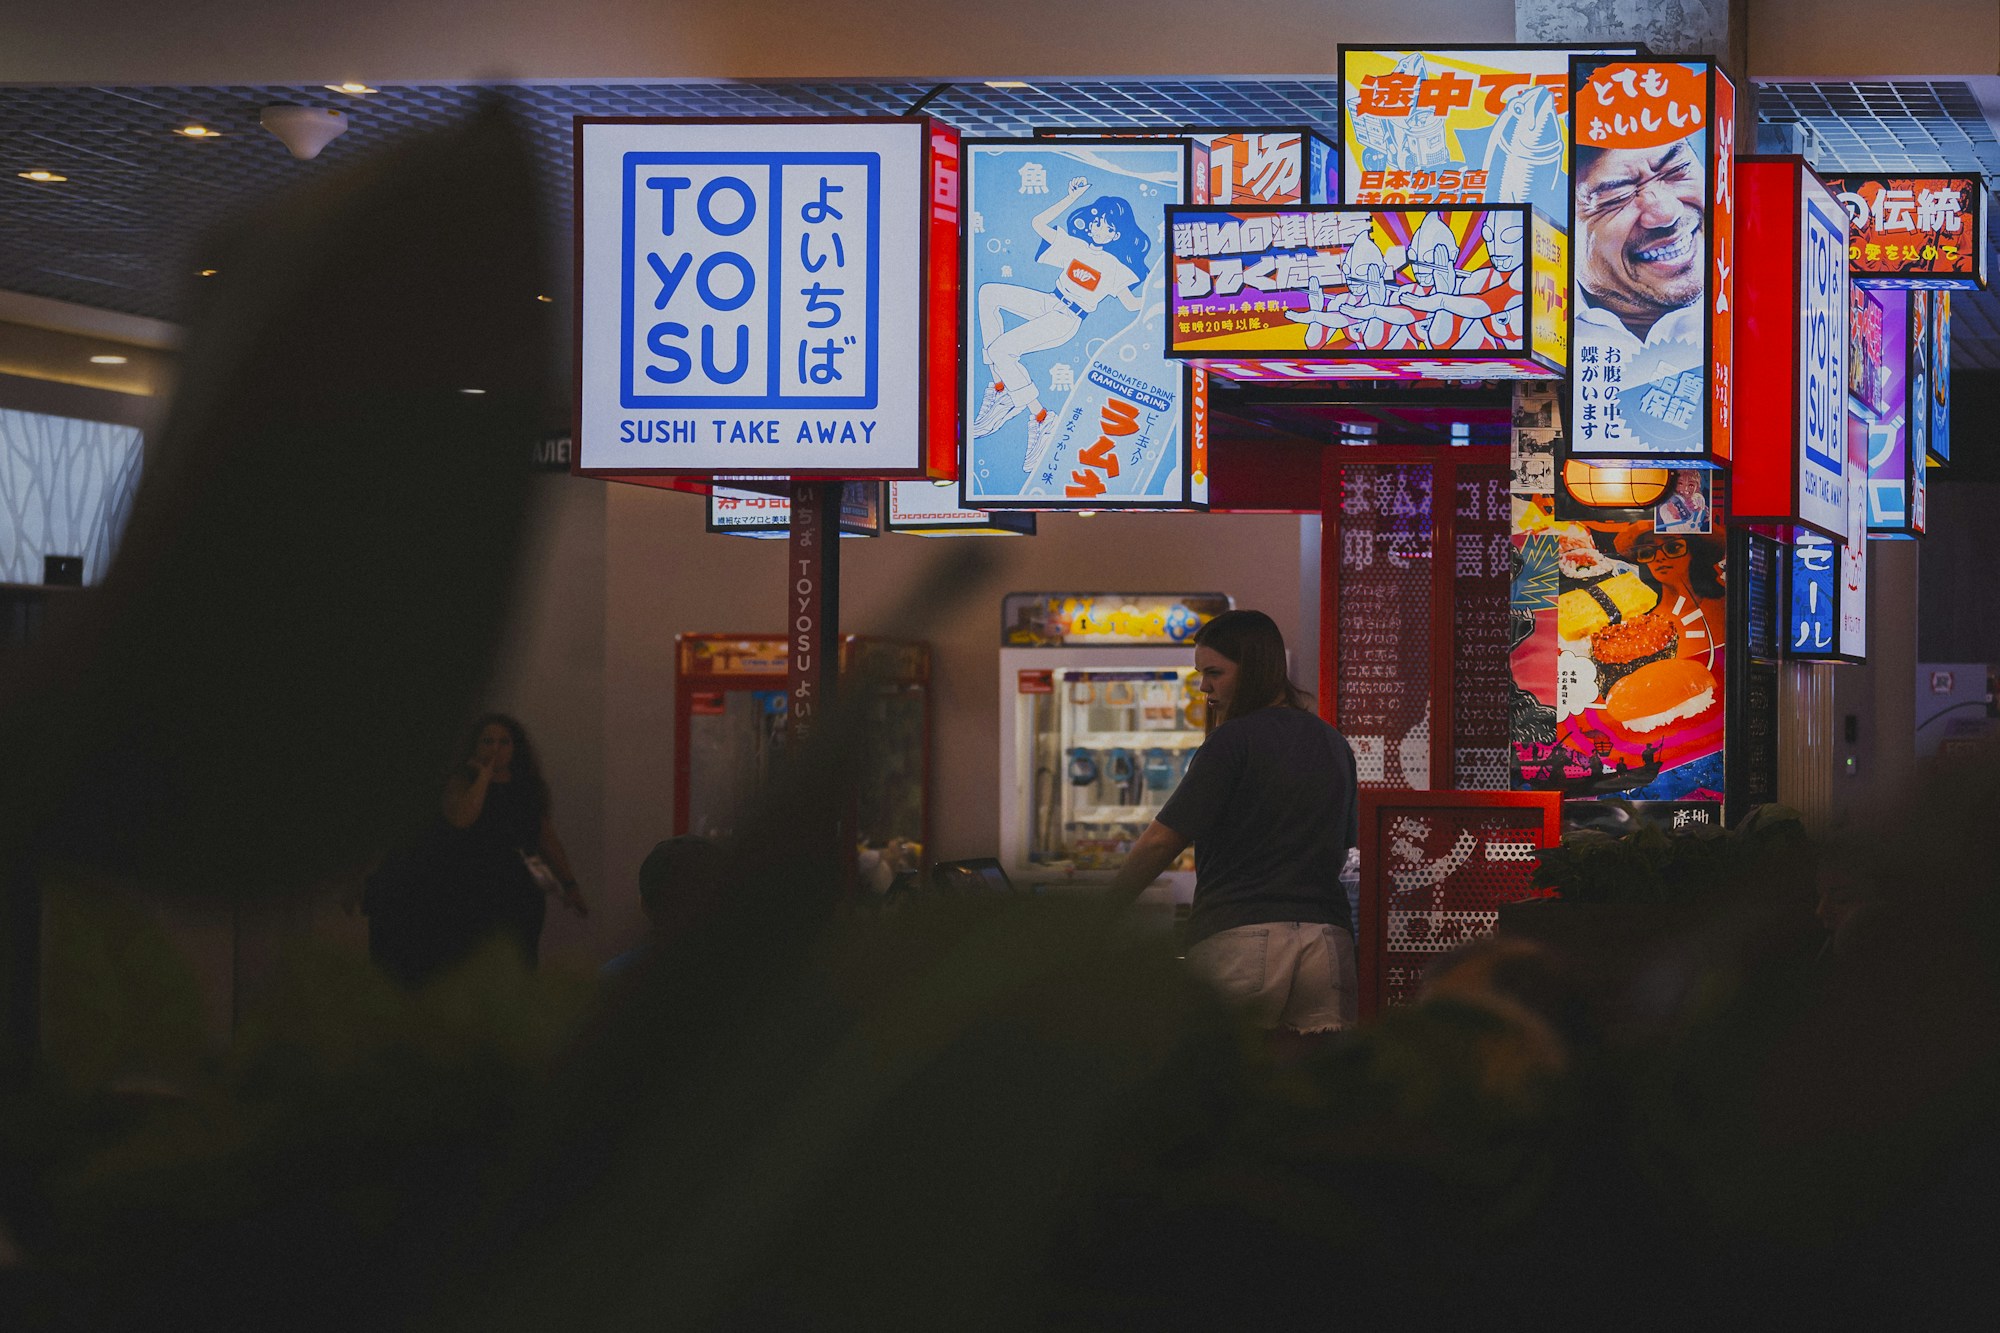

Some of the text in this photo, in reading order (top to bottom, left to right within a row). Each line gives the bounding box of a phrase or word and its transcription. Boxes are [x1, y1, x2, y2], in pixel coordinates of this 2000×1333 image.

[1594, 69, 1668, 105] とても
[1588, 101, 1701, 142] おいしい
[646, 176, 756, 236] TO
[1018, 161, 1050, 194] 魚
[1360, 170, 1488, 190] 日本から直
[647, 251, 755, 312] YO
[799, 177, 856, 385] よいちば
[1811, 227, 1827, 296] TO
[645, 322, 749, 384] SU
[1810, 303, 1827, 371] YO
[1049, 363, 1075, 391] 魚
[1091, 372, 1167, 411] RAMUNE DRINK
[1093, 361, 1176, 403] CARBONATED DRINK
[1581, 346, 1599, 440] 蝶がいます
[1603, 346, 1621, 439] お腹の中に
[620, 420, 877, 444] SUSHI TAKE AWAY
[1809, 374, 1826, 443] SU
[1042, 407, 1083, 485] 昔なつかしい味
[1065, 397, 1141, 498] ラムネ
[1130, 412, 1160, 466] ビー玉入り
[717, 516, 791, 525] 繊細なマグロと美味
[796, 560, 813, 671] TOYOSU
